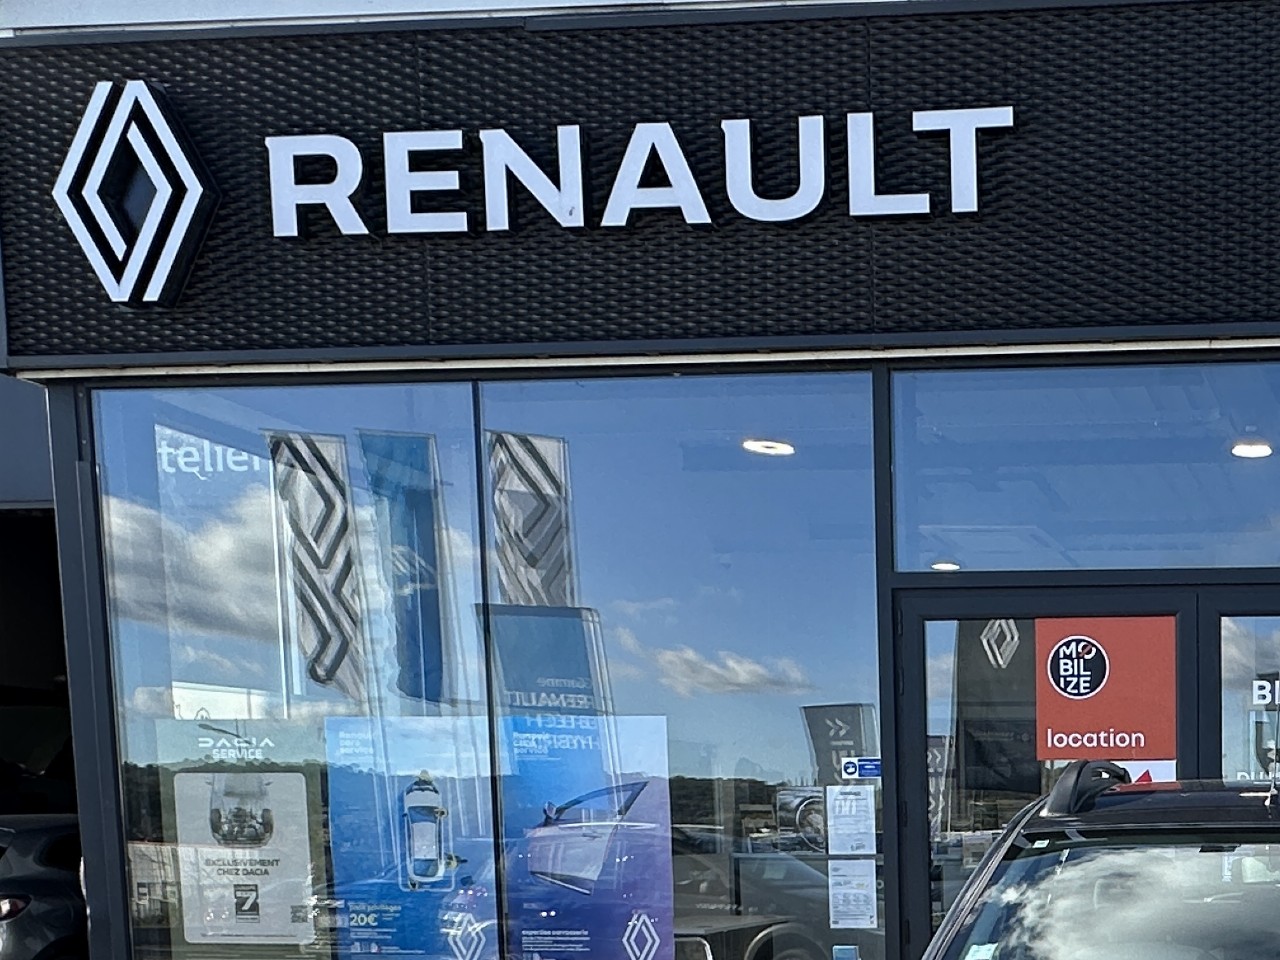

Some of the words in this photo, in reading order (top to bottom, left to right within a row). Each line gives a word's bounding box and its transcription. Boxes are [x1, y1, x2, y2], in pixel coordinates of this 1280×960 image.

[264, 106, 1014, 236] RENAULT
[1047, 728, 1145, 748] location
[212, 749, 263, 759] SERVICE
[349, 912, 379, 927] 20€
